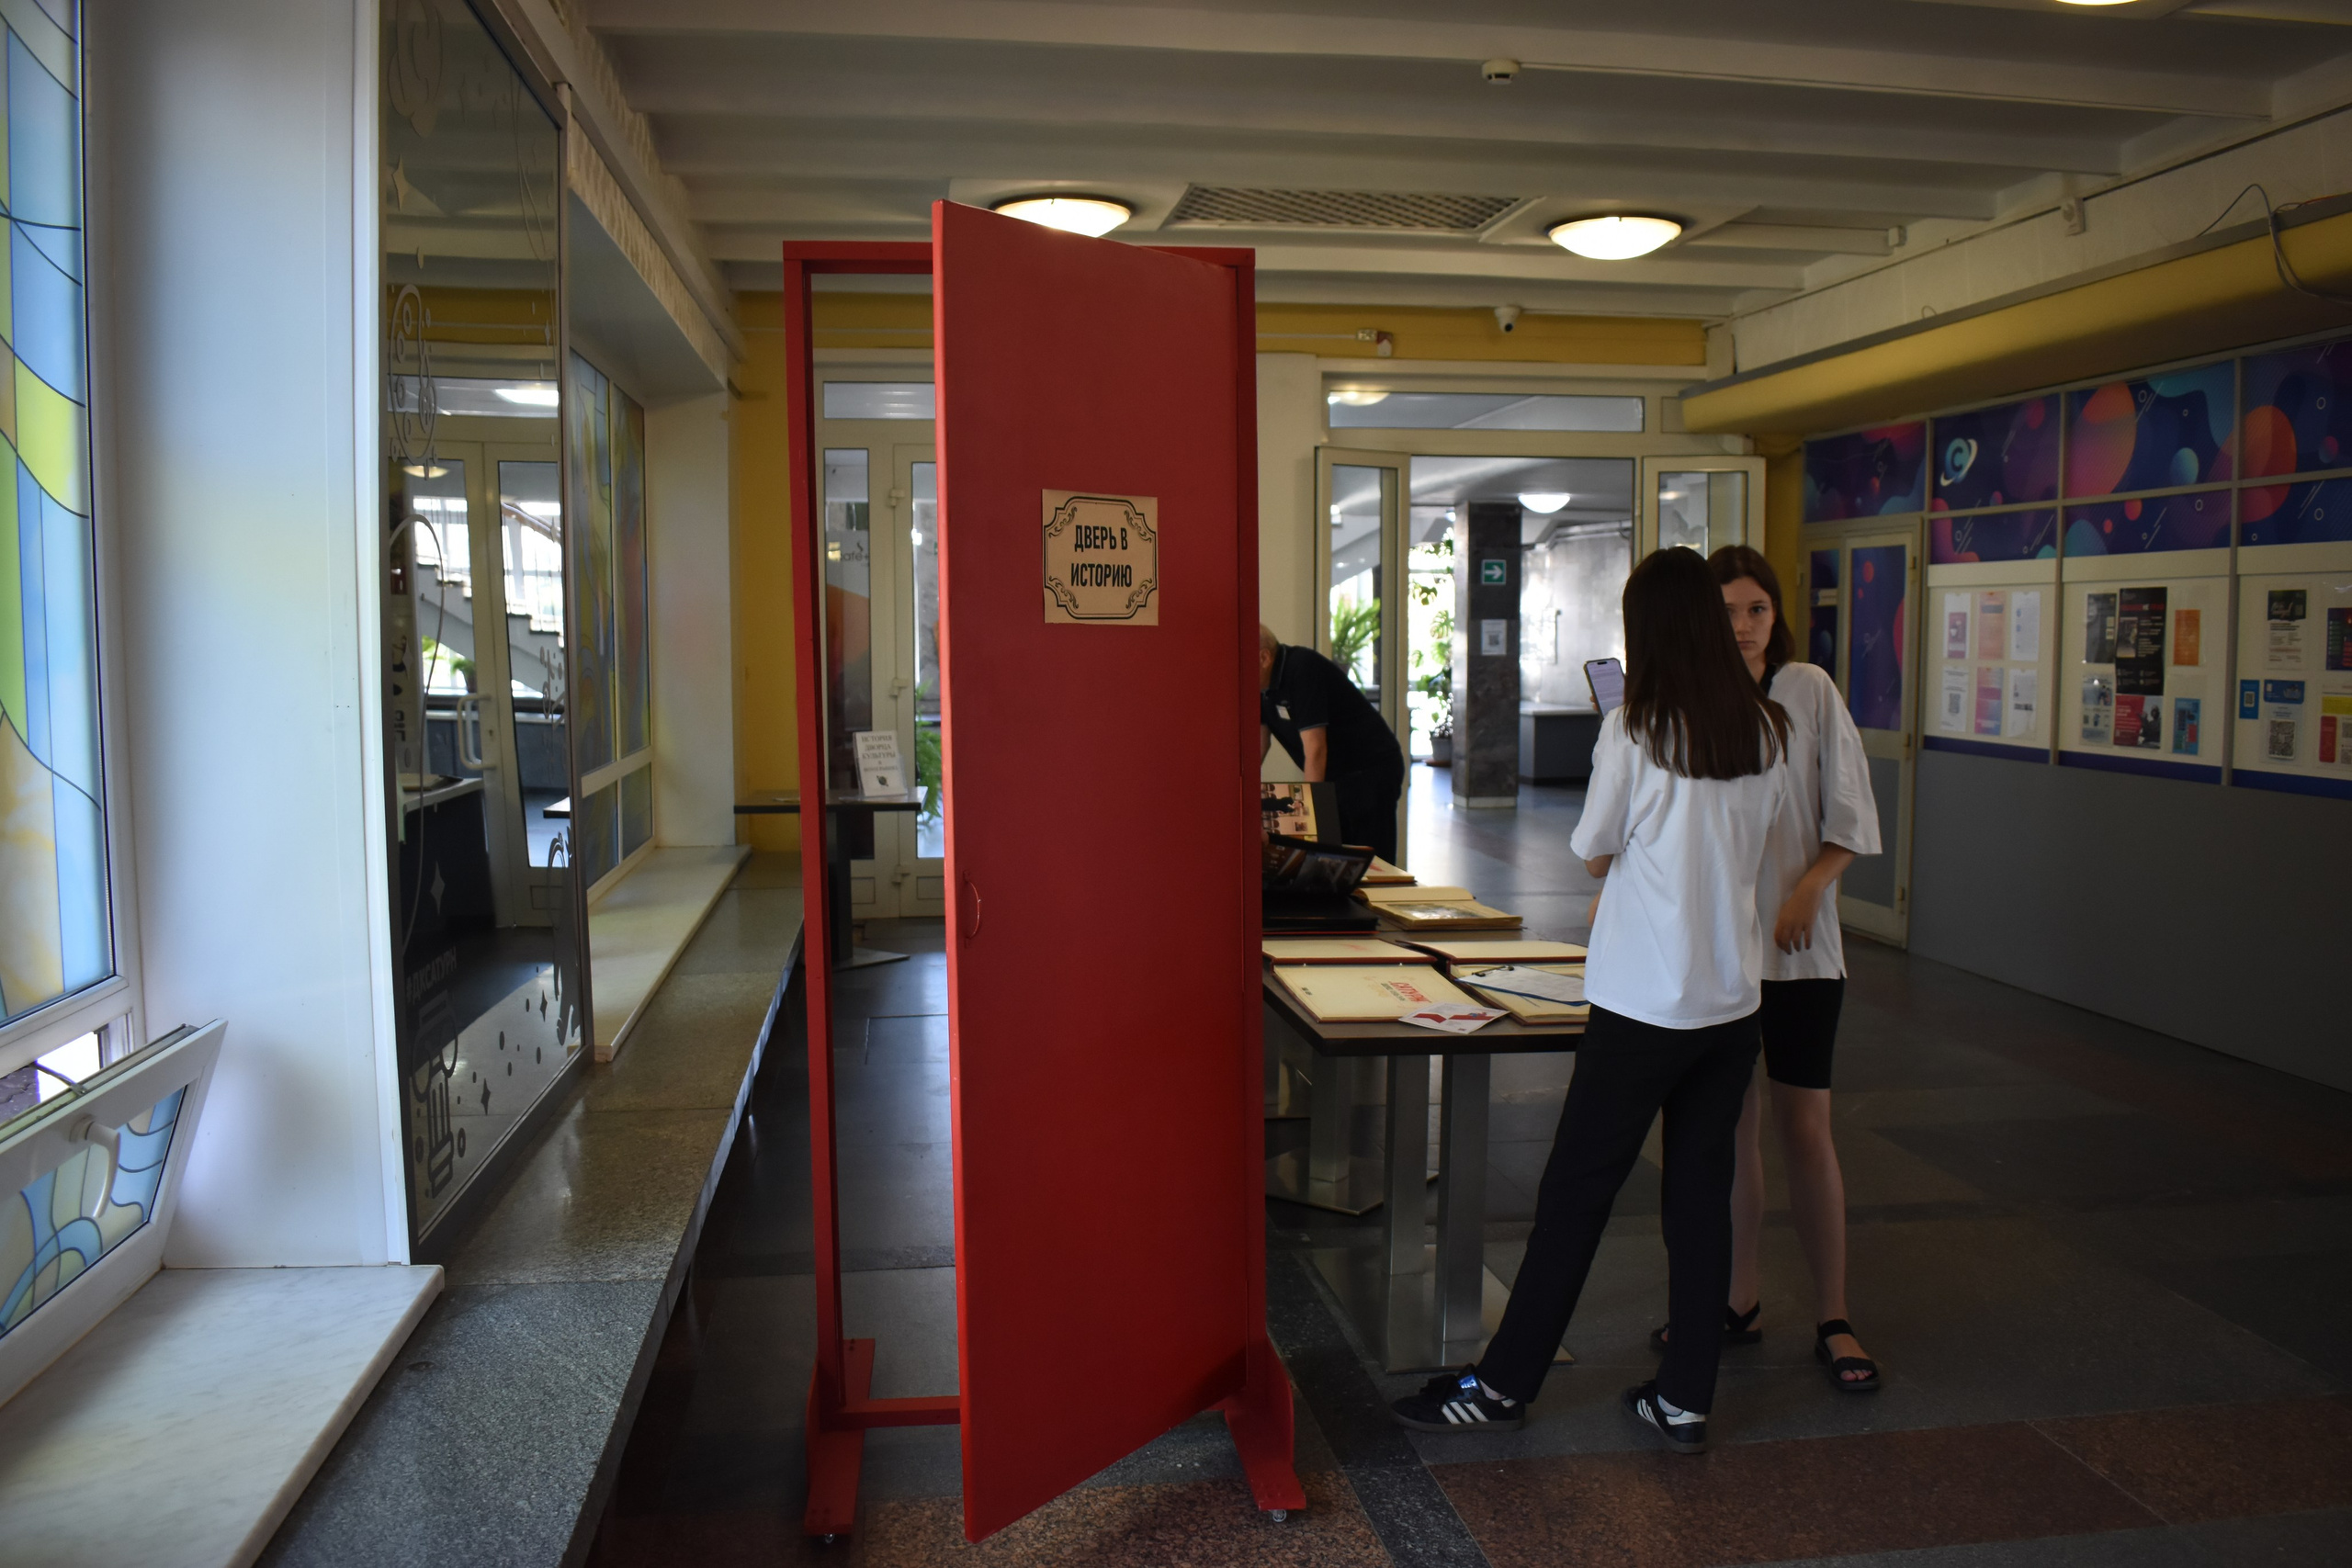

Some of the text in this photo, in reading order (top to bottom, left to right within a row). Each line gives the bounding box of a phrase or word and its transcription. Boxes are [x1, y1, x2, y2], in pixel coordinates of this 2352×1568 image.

[1074, 525, 1128, 553] ДВЕРЬ В
[1070, 563, 1133, 588] ИСТОРИЮ
